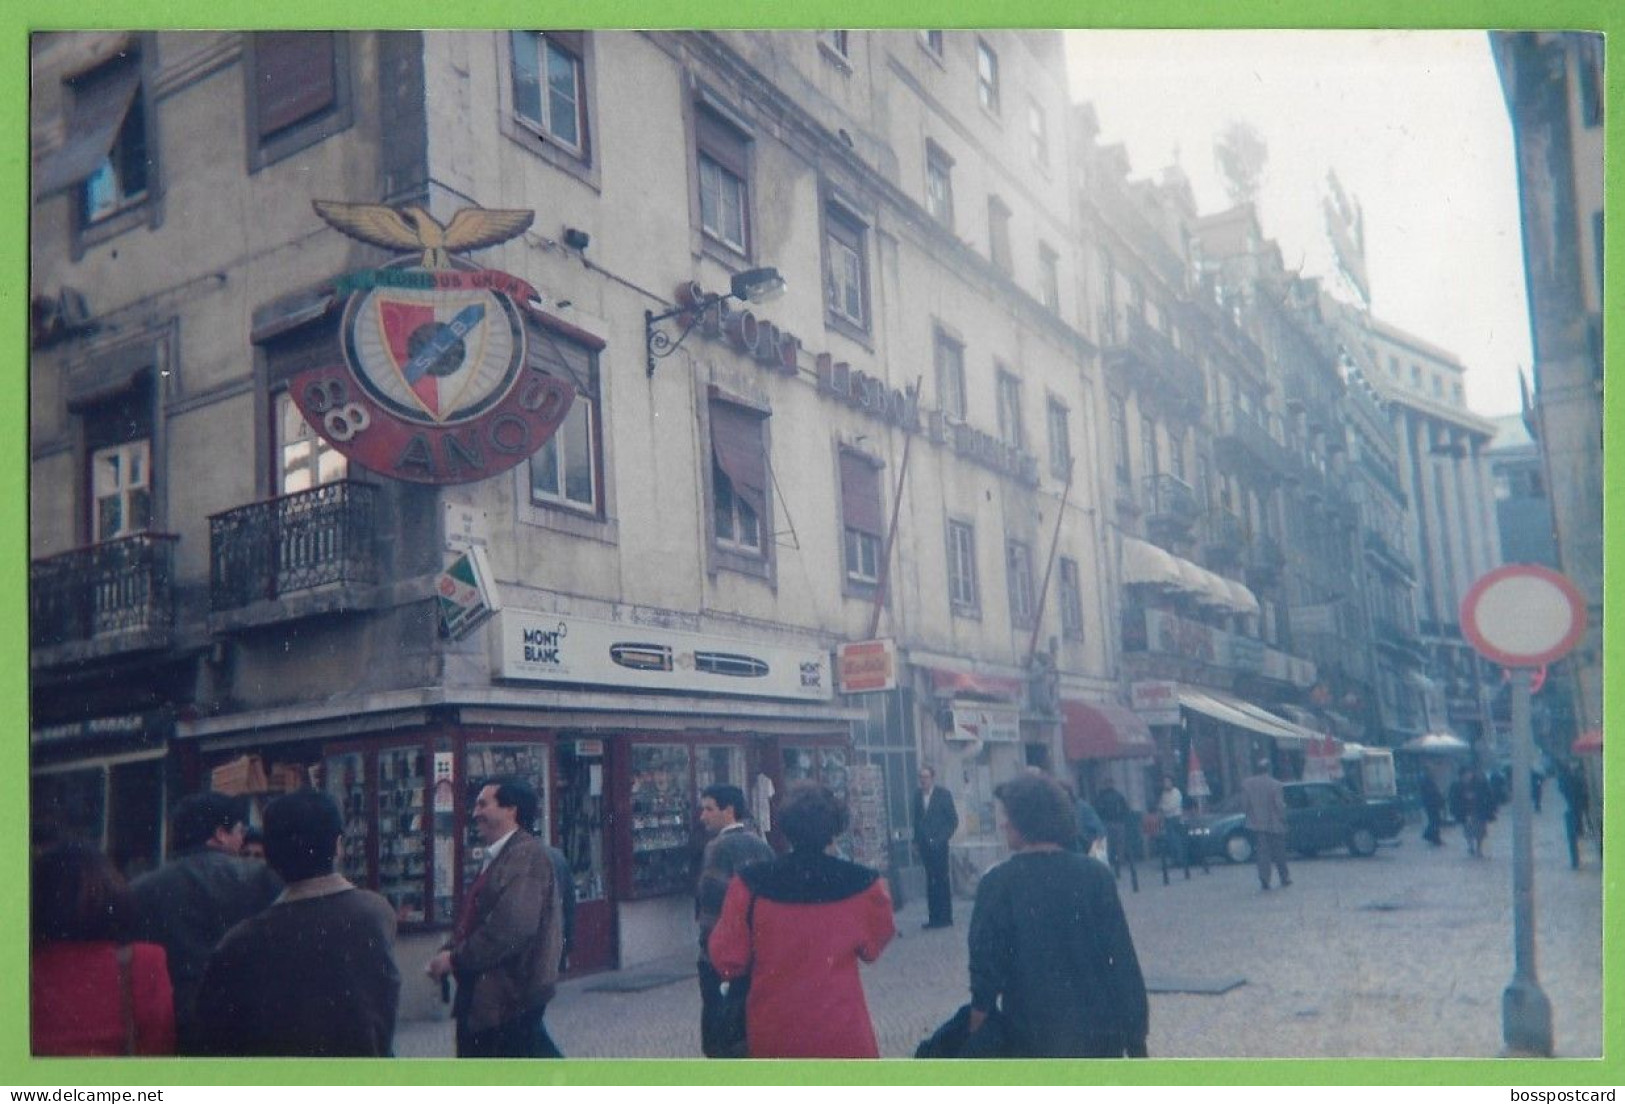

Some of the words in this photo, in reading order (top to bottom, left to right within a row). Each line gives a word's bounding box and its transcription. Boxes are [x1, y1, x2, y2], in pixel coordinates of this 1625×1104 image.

[304, 378, 370, 442] 88
[396, 377, 563, 474] ANOS
[523, 628, 559, 647] MONT
[524, 645, 560, 664] BLANC
